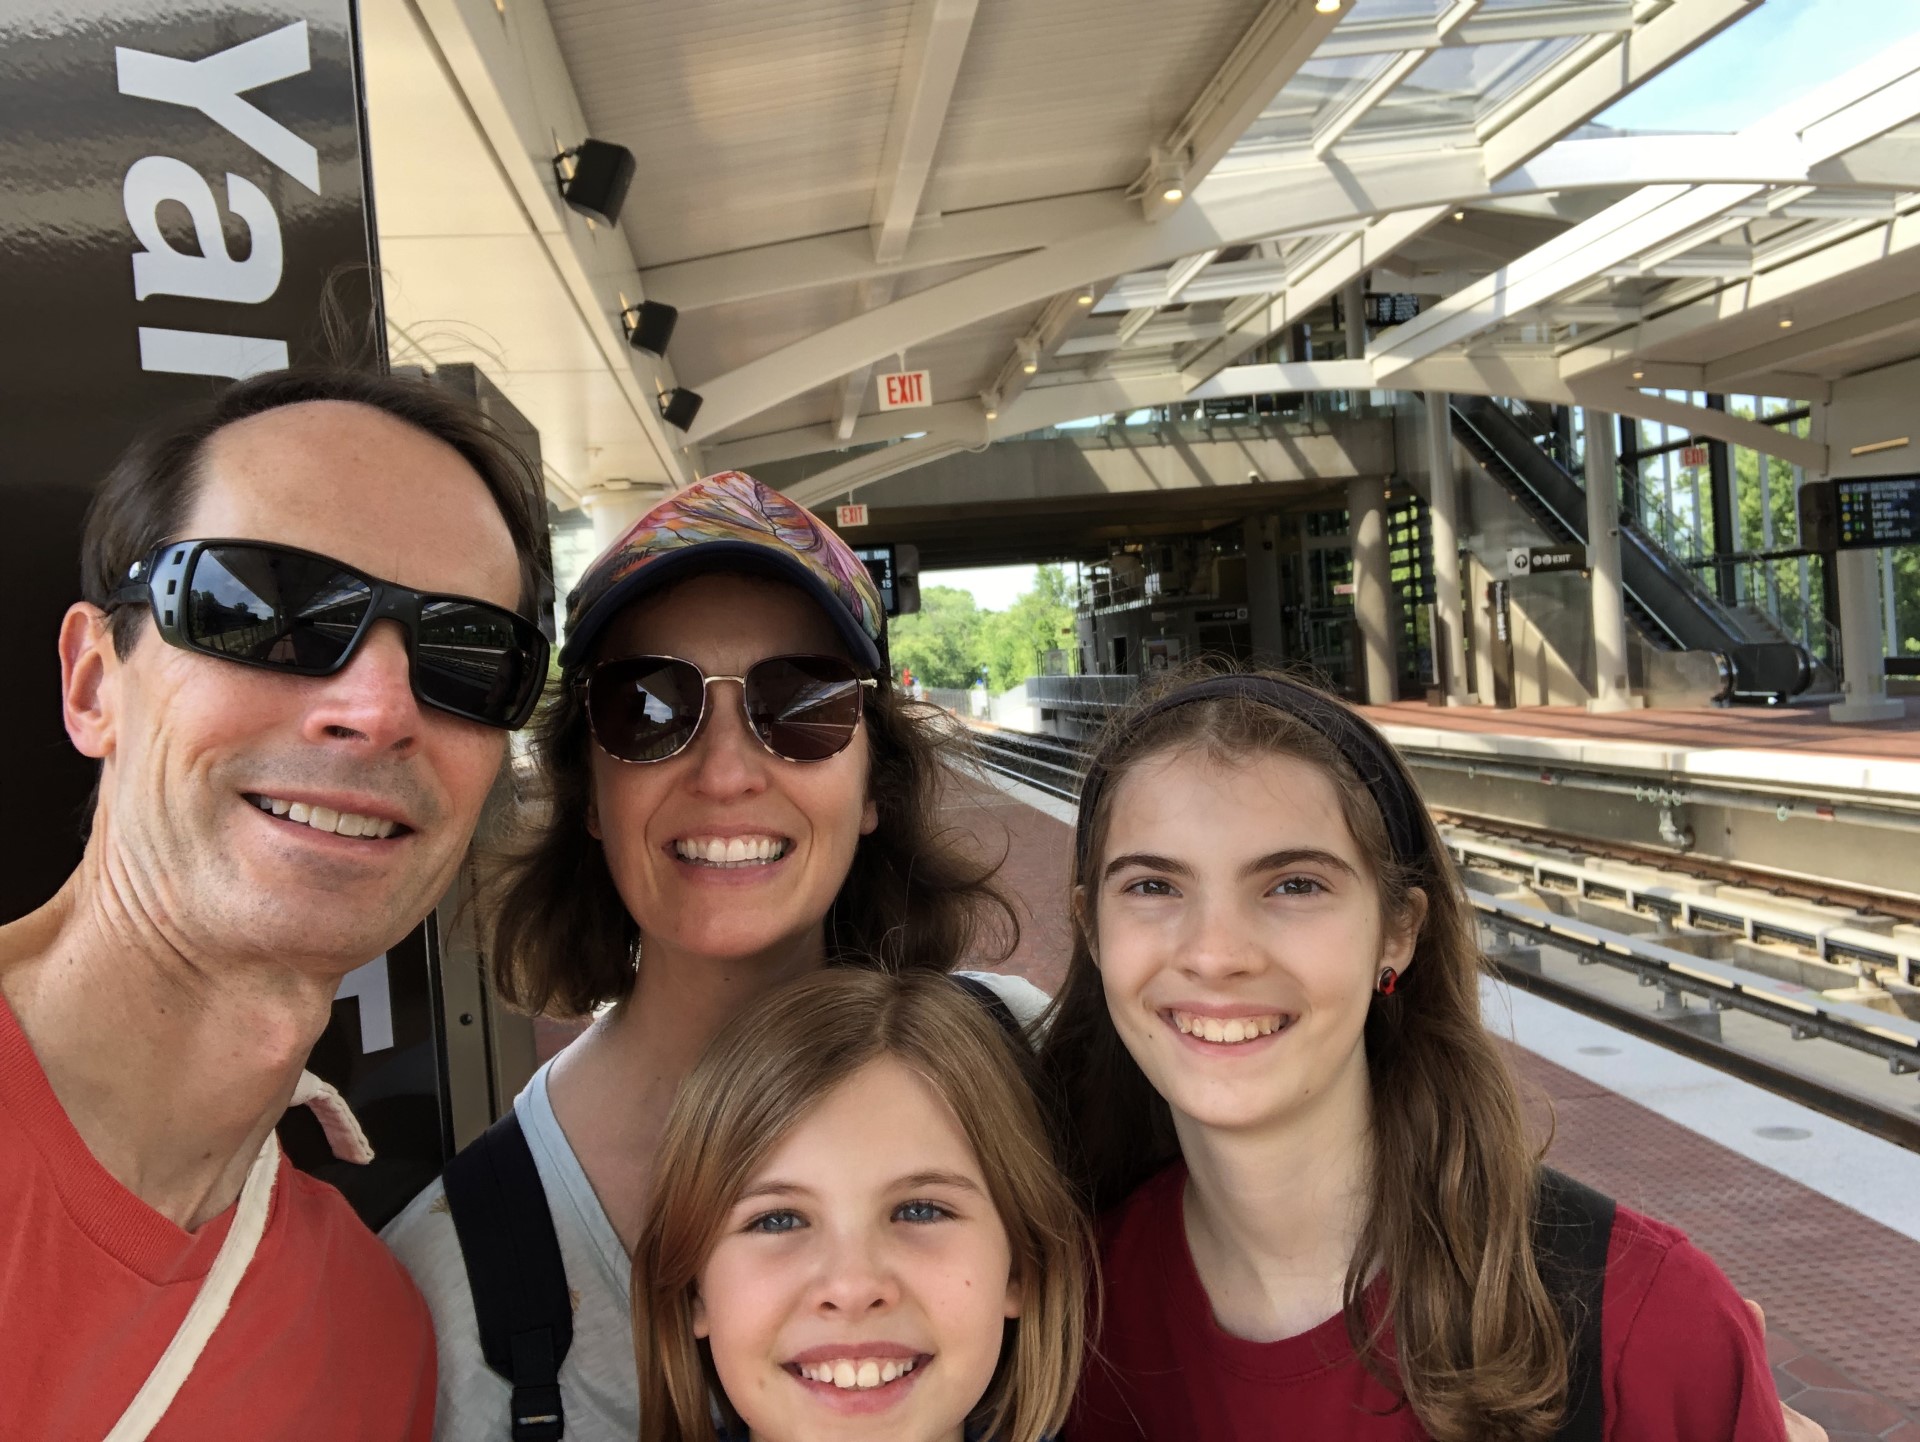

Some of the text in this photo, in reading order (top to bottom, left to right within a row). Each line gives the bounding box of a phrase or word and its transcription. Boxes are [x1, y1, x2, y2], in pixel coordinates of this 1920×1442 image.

[886, 373, 923, 405] EXIT
[1684, 447, 1706, 467] EXIT
[841, 506, 863, 524] EXIT
[873, 548, 890, 560] MIN
[1552, 554, 1571, 564] EXIT
[885, 560, 890, 569] 1
[884, 569, 892, 579] 3
[881, 579, 892, 589] 15
